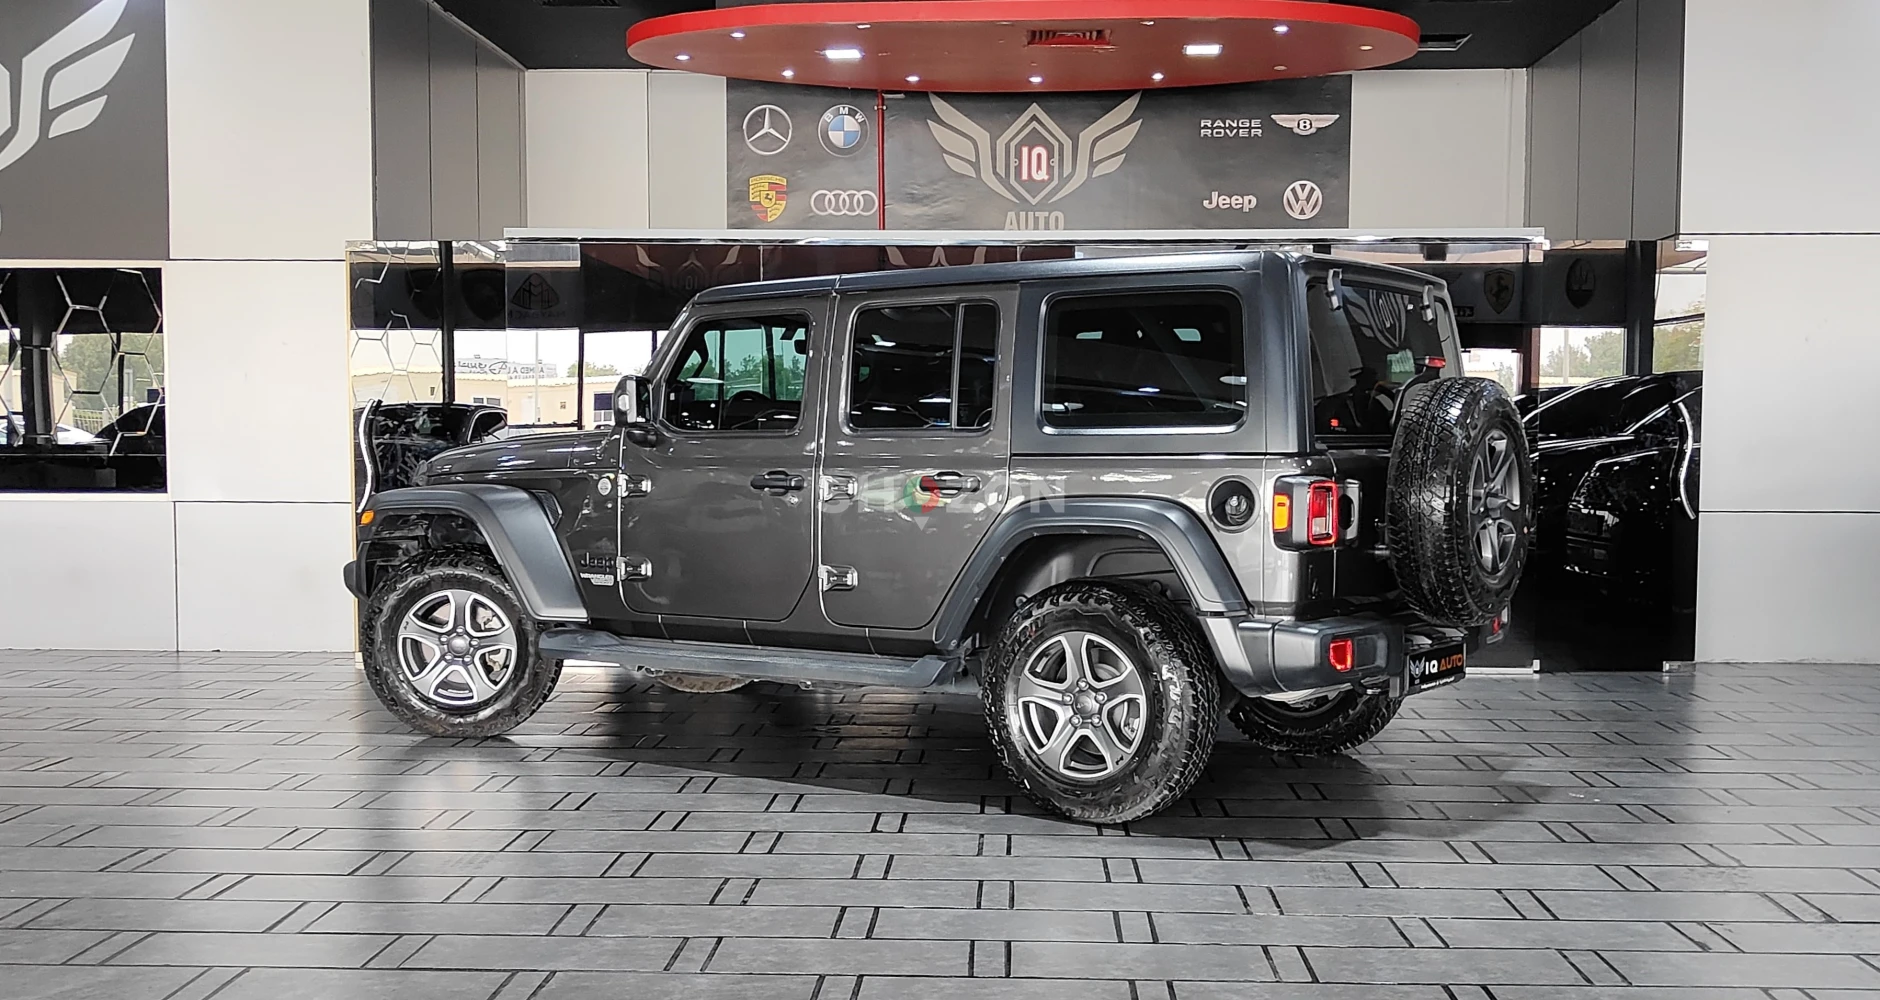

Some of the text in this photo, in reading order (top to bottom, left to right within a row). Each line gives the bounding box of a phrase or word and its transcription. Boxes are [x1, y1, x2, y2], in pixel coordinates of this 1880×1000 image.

[1201, 119, 1262, 128] RANGE
[1201, 129, 1263, 138] ROVER
[1021, 146, 1050, 181] IQ
[1203, 191, 1257, 212] Jeep
[1004, 210, 1065, 231] AUTO
[580, 552, 615, 572] Jeep
[1425, 653, 1463, 675] IQ AUTO
